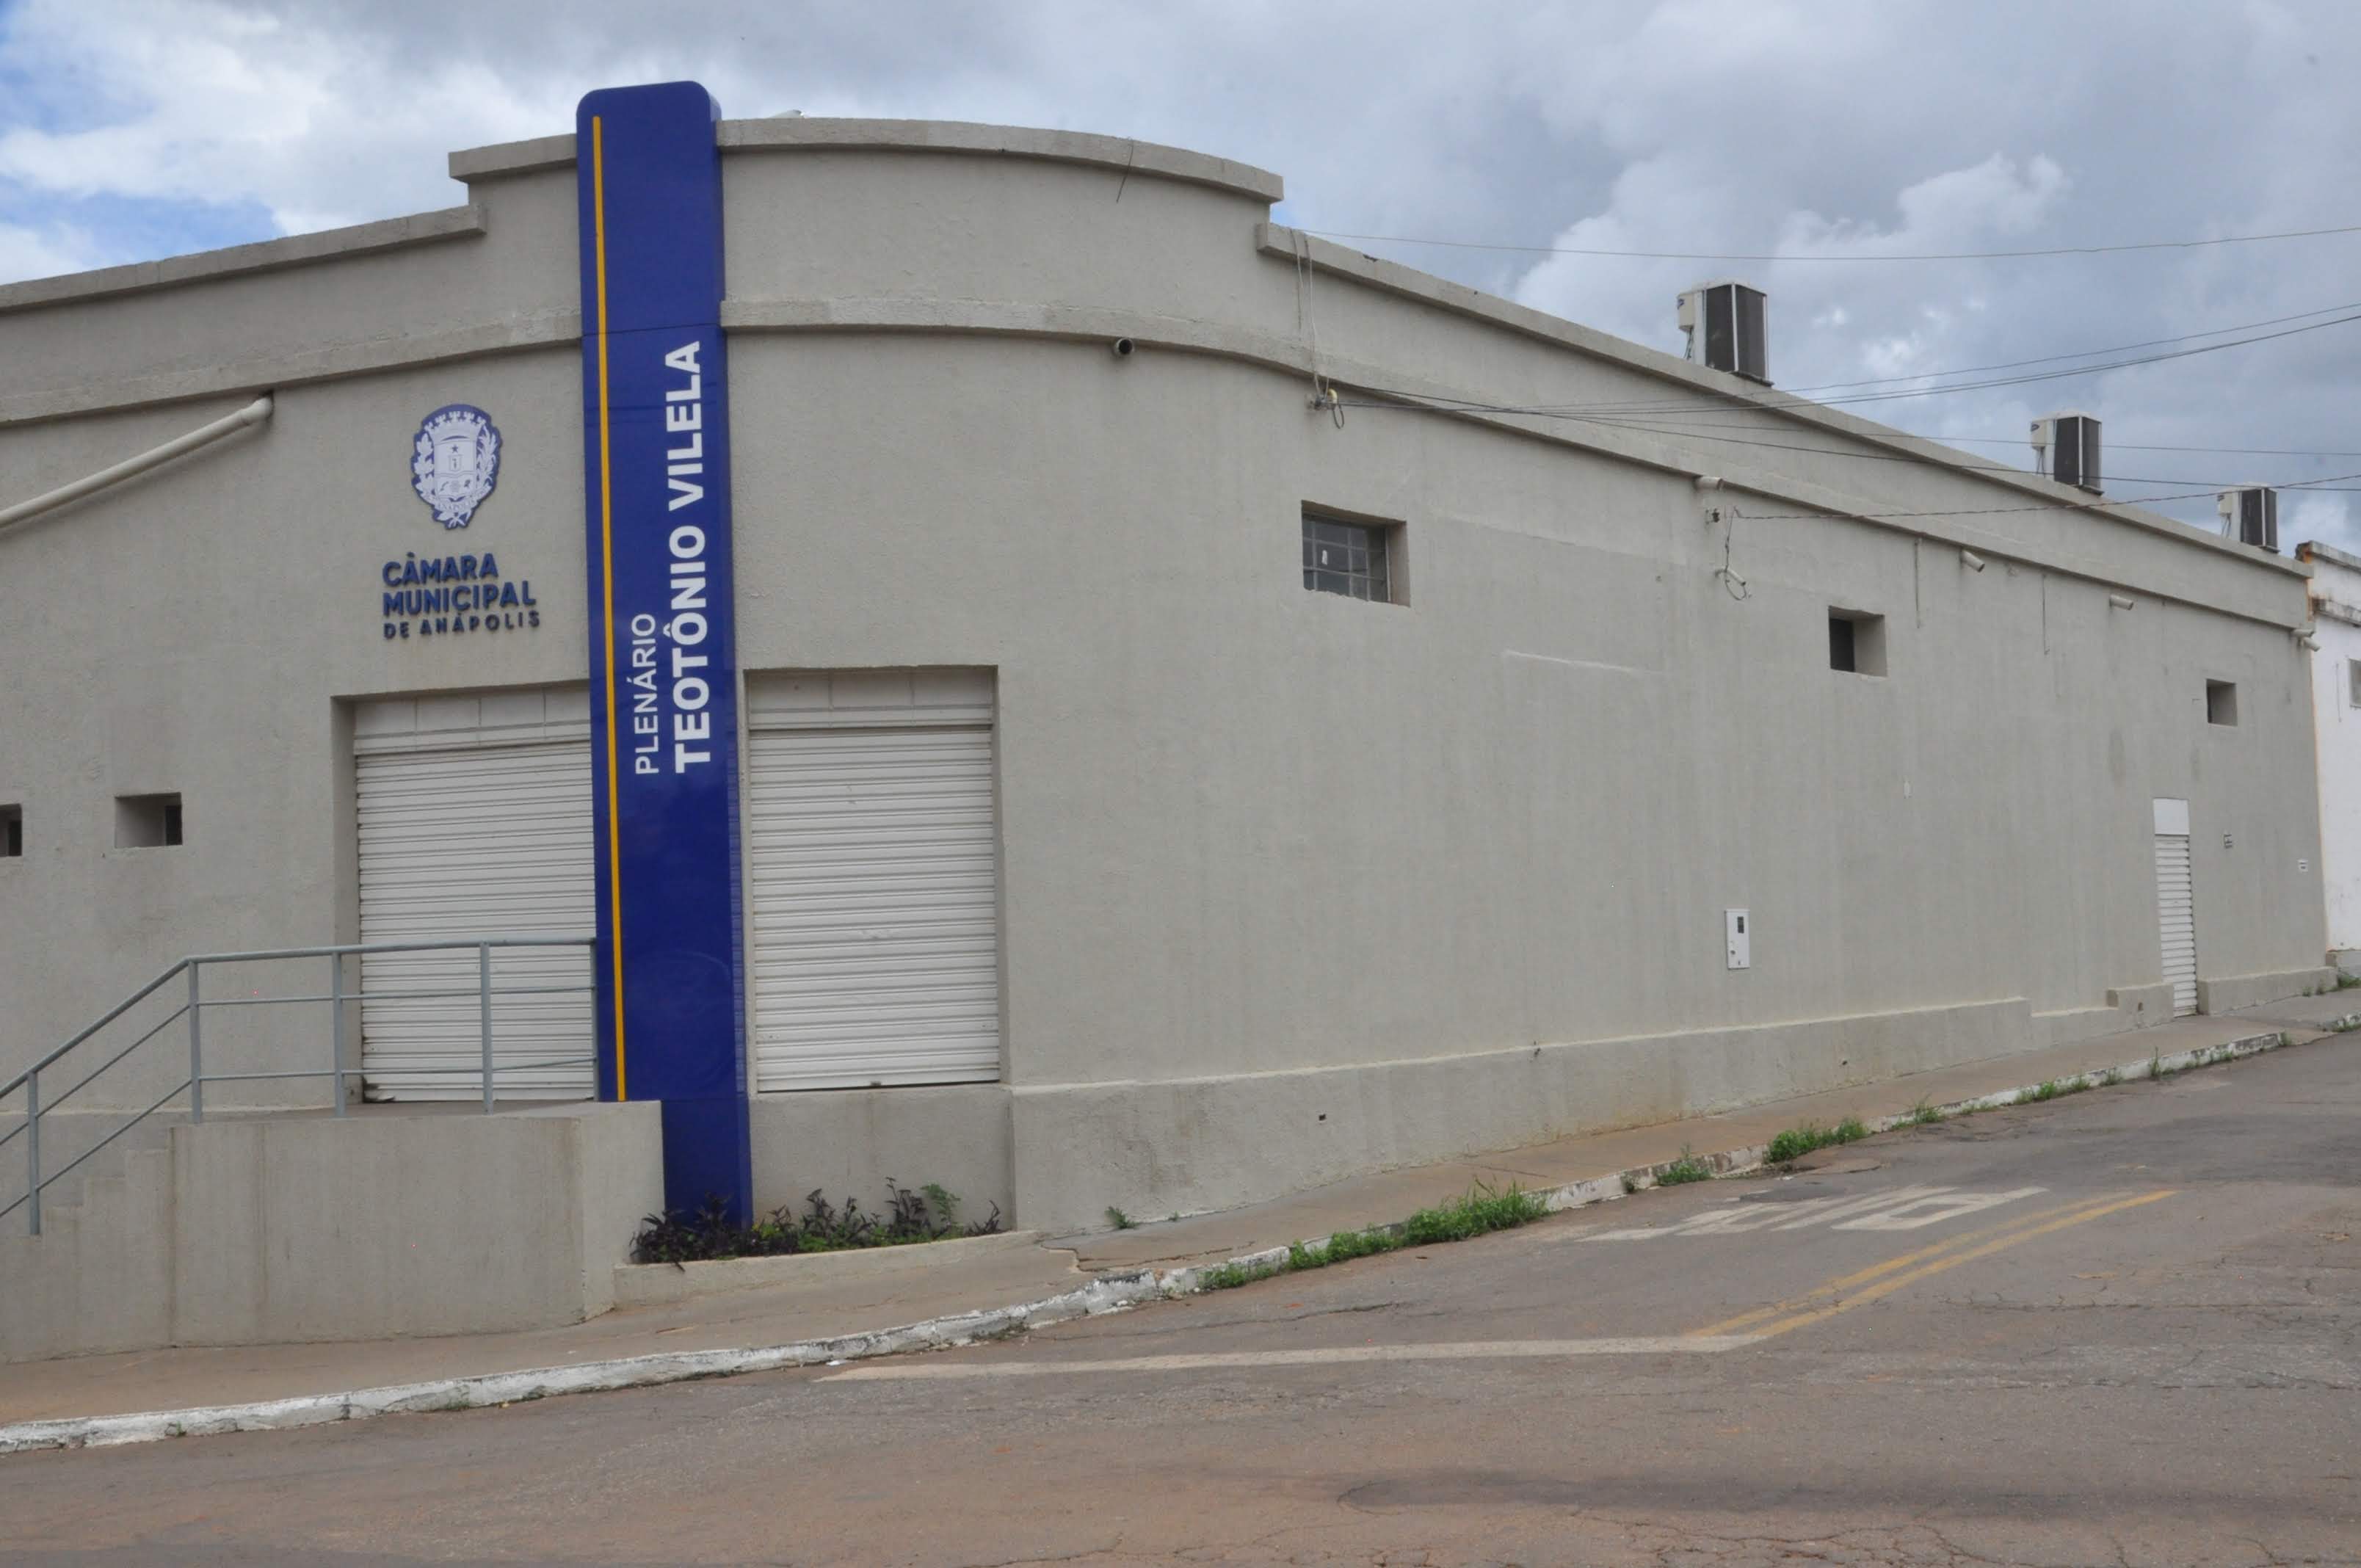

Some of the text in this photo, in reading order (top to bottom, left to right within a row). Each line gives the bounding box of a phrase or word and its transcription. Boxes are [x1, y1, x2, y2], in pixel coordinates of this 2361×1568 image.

[382, 552, 498, 587] CÂMARA
[663, 341, 711, 774] TEOTÔNIO VILELA
[382, 581, 537, 617] MUNICIPAL
[383, 610, 540, 639] DE ANÁPOLIS
[628, 613, 659, 774] PLENÁRIO
